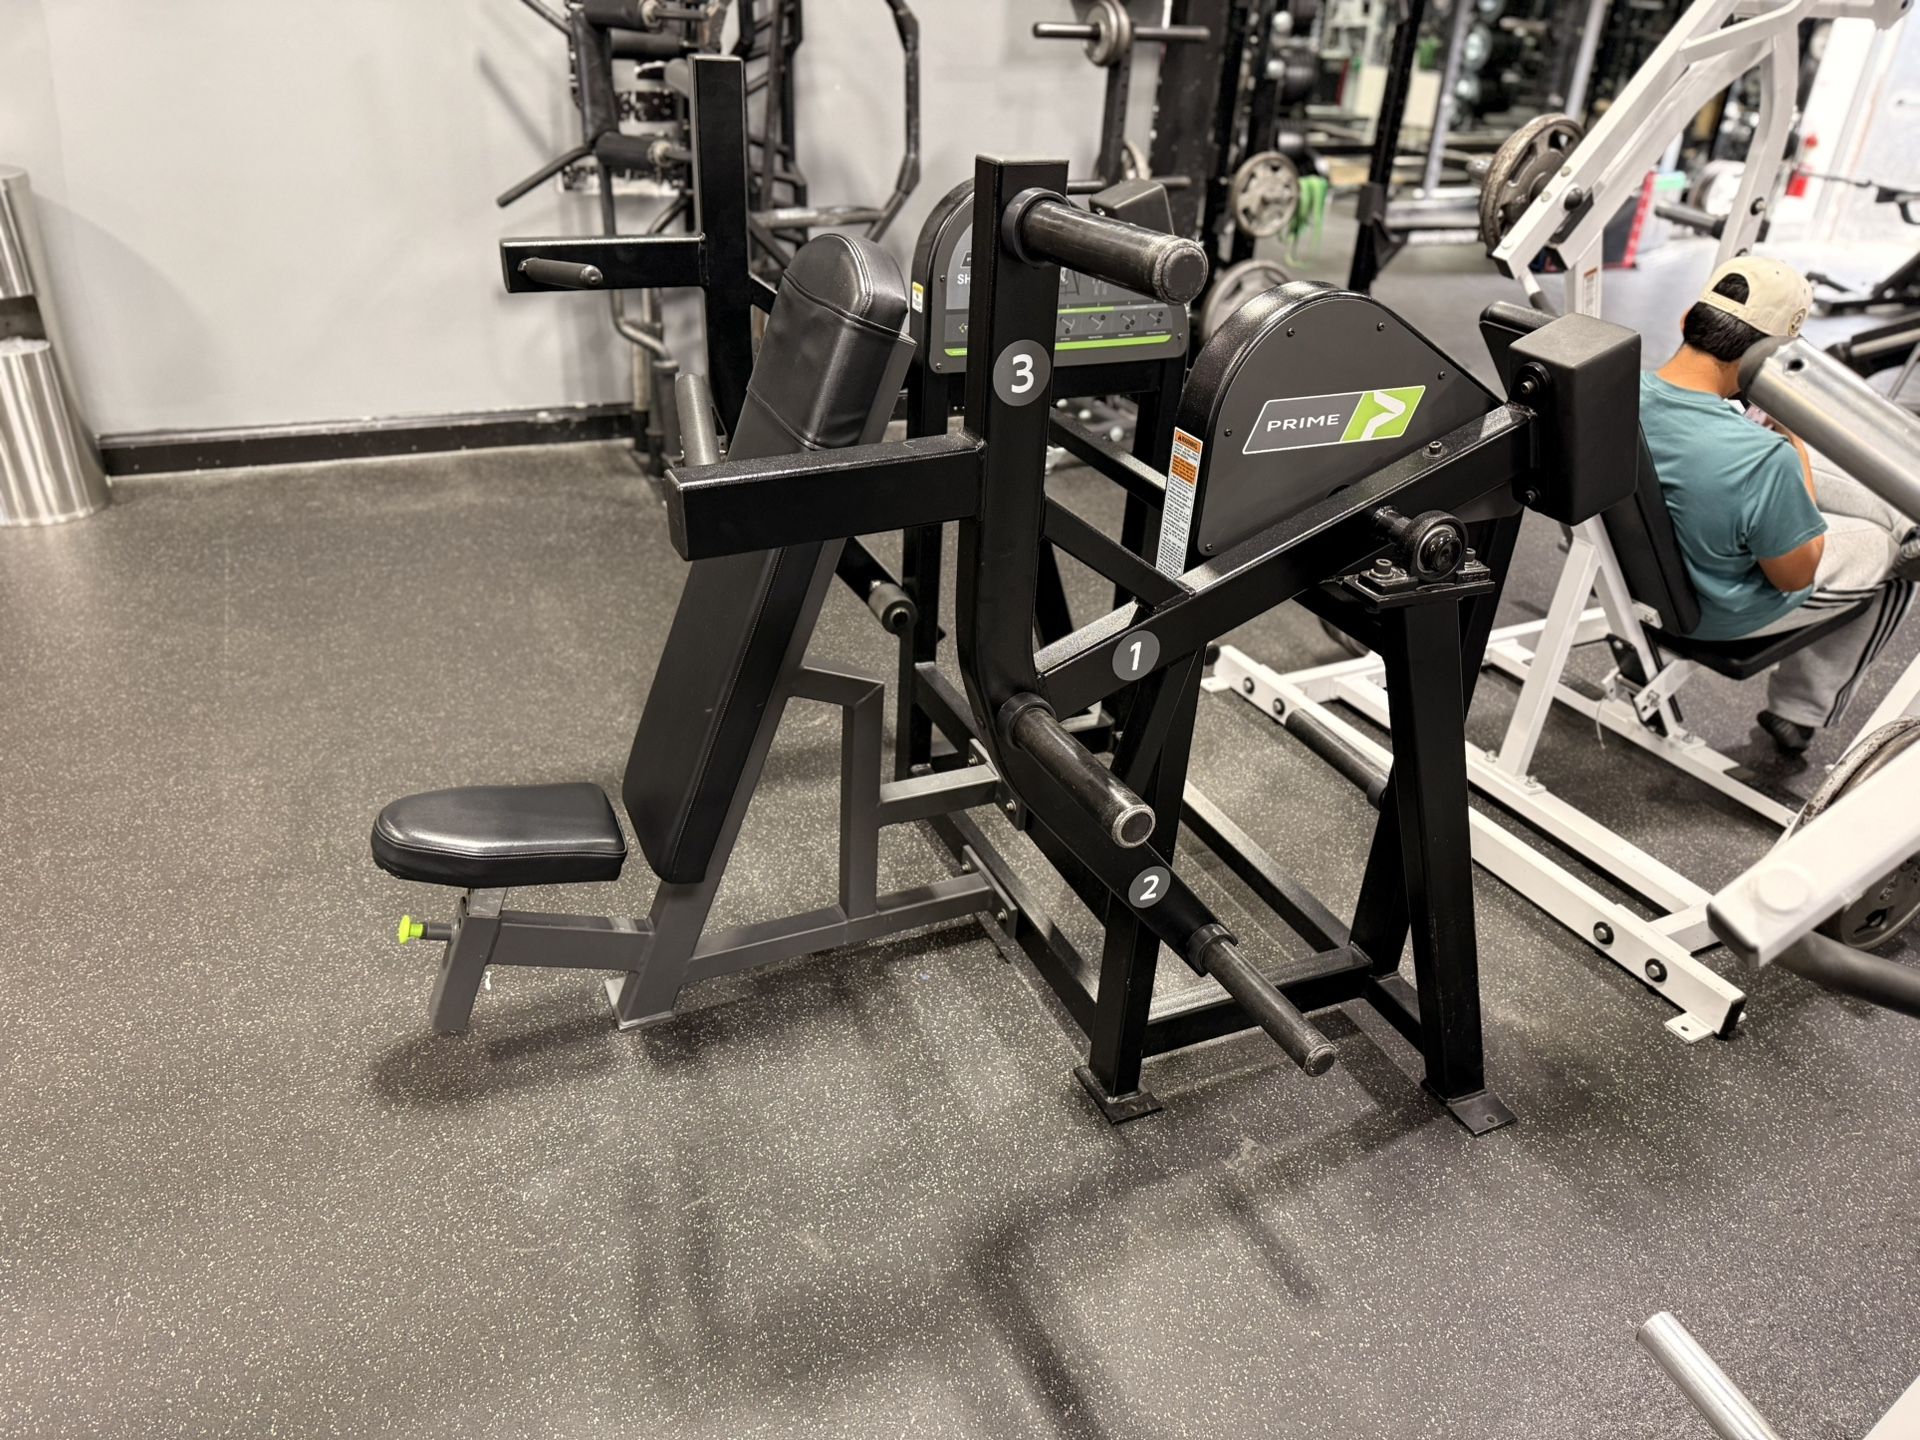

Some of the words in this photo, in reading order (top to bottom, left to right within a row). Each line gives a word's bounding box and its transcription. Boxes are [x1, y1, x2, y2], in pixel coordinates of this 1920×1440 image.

[1011, 353, 1035, 394] 3
[1266, 413, 1341, 432] PRIME
[1129, 641, 1142, 671] 1
[1139, 874, 1160, 901] 2
